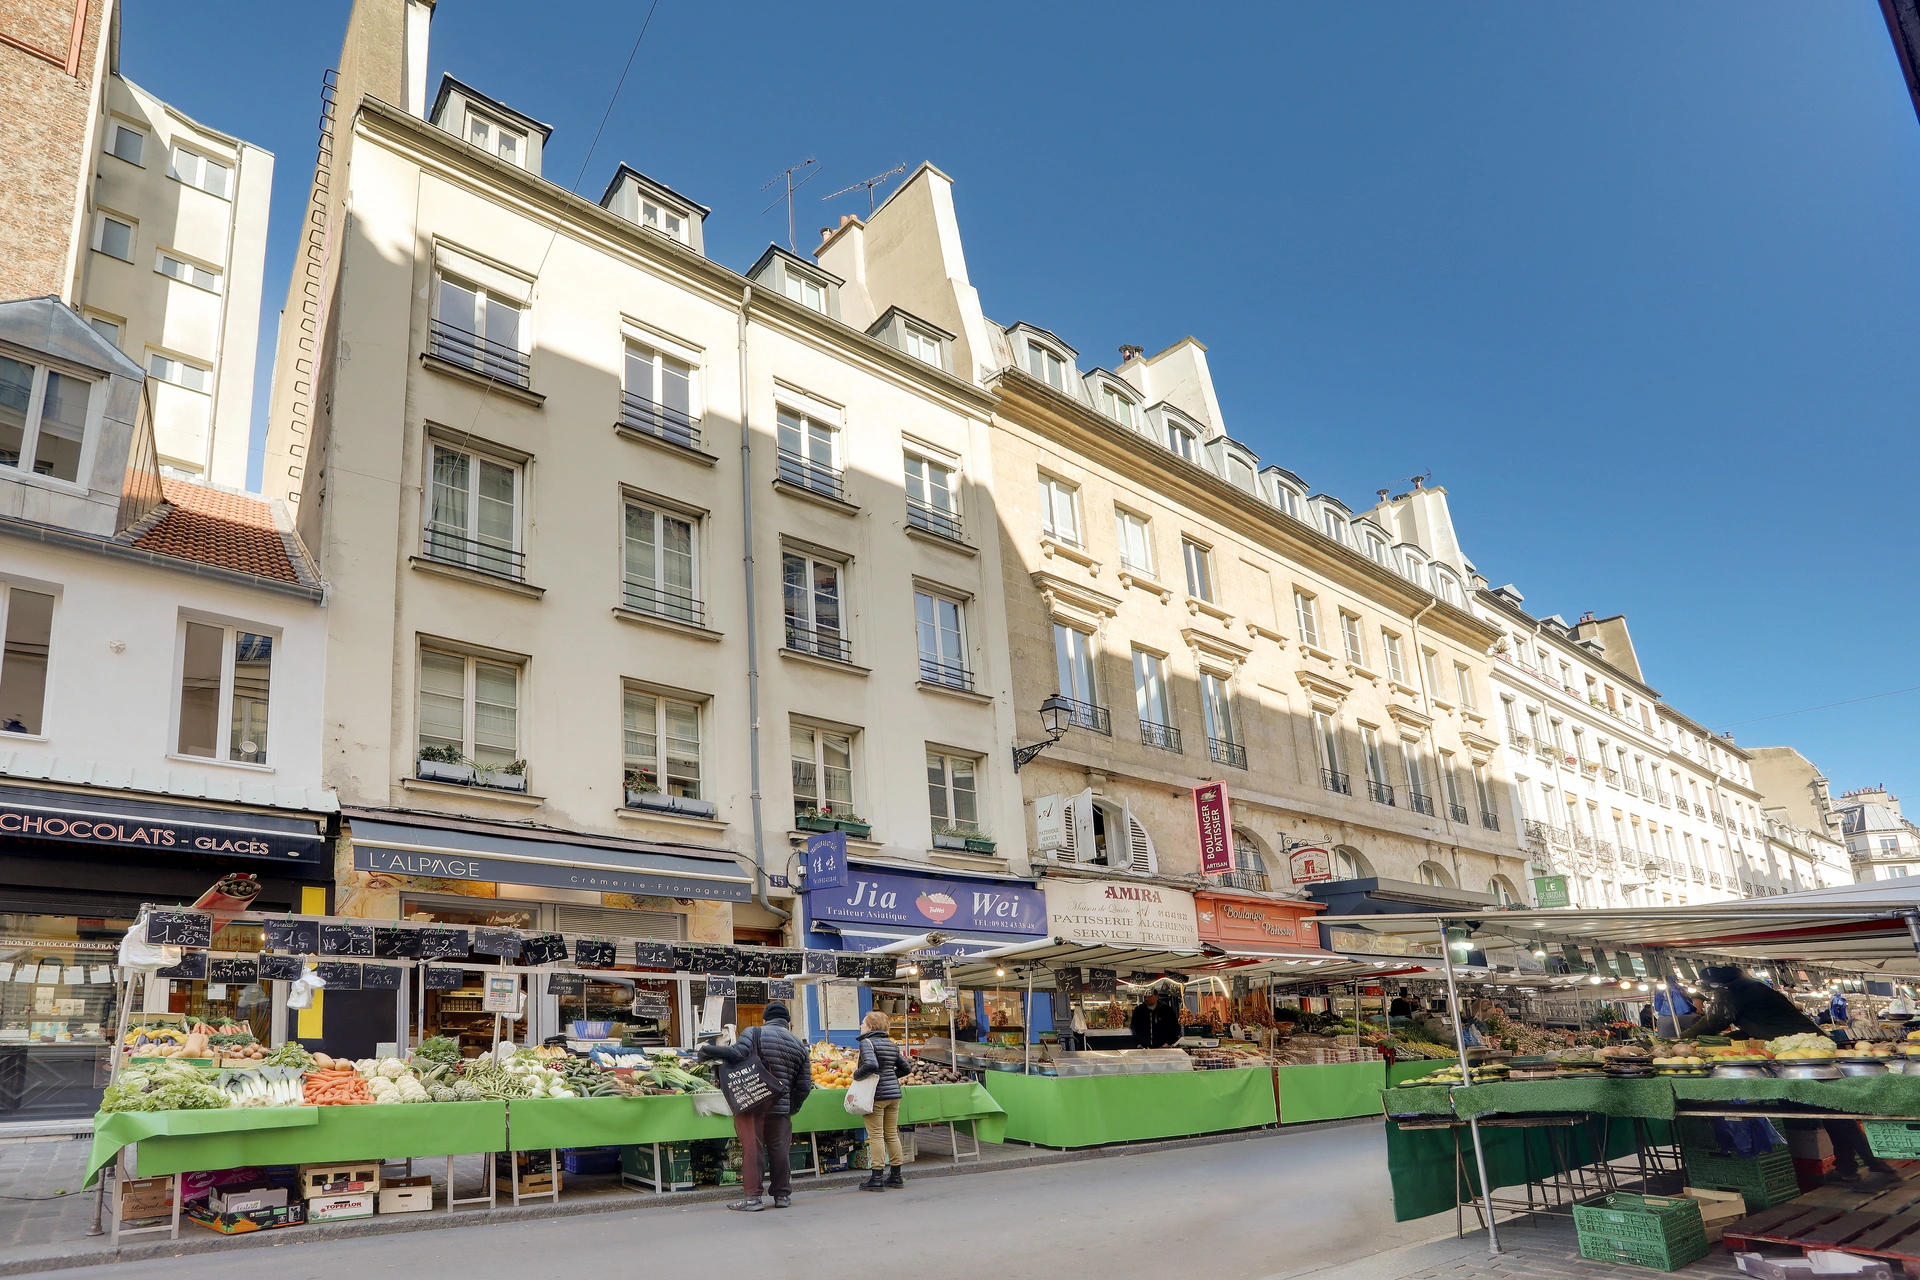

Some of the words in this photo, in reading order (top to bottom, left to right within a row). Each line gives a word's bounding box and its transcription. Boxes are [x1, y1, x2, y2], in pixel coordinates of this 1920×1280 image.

[0, 813, 175, 846] CHOCOLATS
[1201, 804, 1215, 860] BOULANGER
[1211, 808, 1224, 852] PATISSIER
[369, 852, 480, 878] L'ALPAGE
[1105, 886, 1162, 903] AMIRA
[1545, 883, 1556, 891] LE
[847, 881, 897, 909] Jia
[972, 892, 1020, 918] Wei
[826, 907, 864, 917] Traiteur
[867, 911, 907, 921] Asiatique
[1222, 904, 1266, 922] Boulanger
[1053, 915, 1134, 926] PATISSERIE
[1138, 920, 1195, 933] ALGERIENNE
[1262, 921, 1296, 936] Pâtissier
[1073, 929, 1133, 939] SERVICE
[1139, 932, 1188, 943] TRAITEUR
[38, 941, 96, 949] CHOCOLATIERS
[325, 1202, 362, 1210] TOPEFLOR
